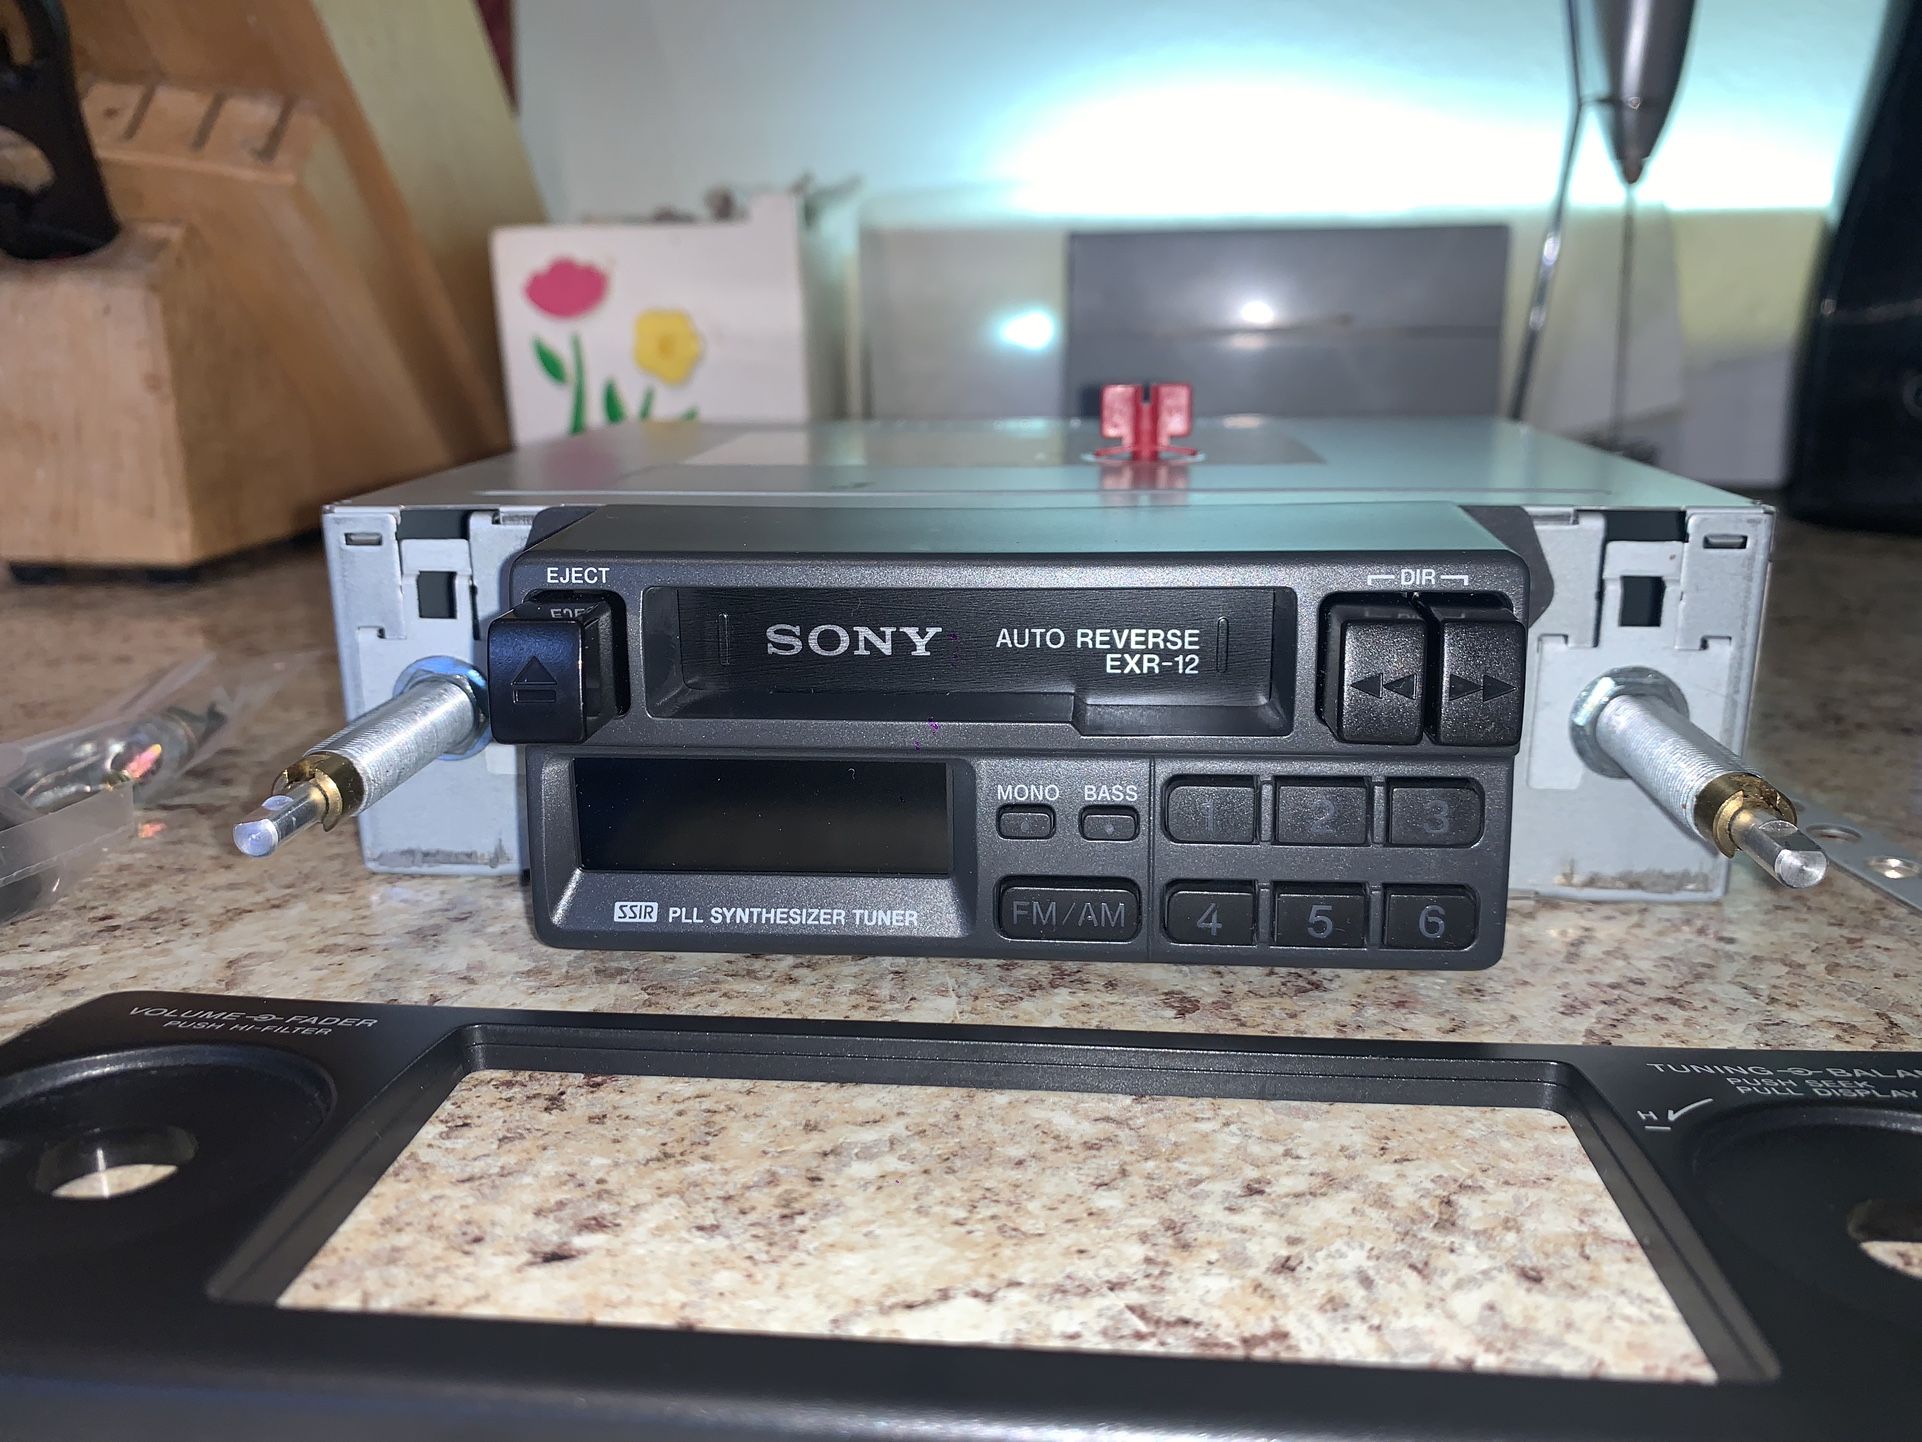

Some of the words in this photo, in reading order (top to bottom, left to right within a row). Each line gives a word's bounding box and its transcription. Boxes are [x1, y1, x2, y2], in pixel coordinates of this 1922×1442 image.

[546, 567, 610, 584] EJECT
[1400, 568, 1436, 585] DIR
[765, 623, 943, 657] SONY
[996, 628, 1065, 650] AUTO
[1076, 628, 1200, 651] REVERSE
[1106, 654, 1200, 675] EXR-12
[997, 784, 1060, 802] MONO
[1083, 784, 1138, 802] BASS
[1202, 799, 1214, 832] 1
[1310, 798, 1338, 833] 2
[1423, 799, 1449, 834] 3
[616, 903, 655, 921] SSIR
[668, 906, 704, 923] PLL
[710, 907, 846, 926] SYNTHESIZER
[852, 909, 918, 927] TUNER
[1012, 900, 1126, 929] FM/AM
[1196, 902, 1223, 936] 4
[1307, 904, 1333, 939] 5
[1418, 904, 1446, 939] 6
[129, 1007, 246, 1021] VOLUME
[284, 1014, 379, 1028] FADER
[163, 1020, 225, 1030] PUSH
[228, 1024, 333, 1036] HI-FILTER
[1646, 1063, 1774, 1076] TUNING
[1726, 1077, 1798, 1087] PUSH
[1804, 1079, 1876, 1088] SEEK
[1736, 1086, 1805, 1096] PULL
[1812, 1088, 1919, 1098] DISPLAY
[1636, 1110, 1658, 1121] H
